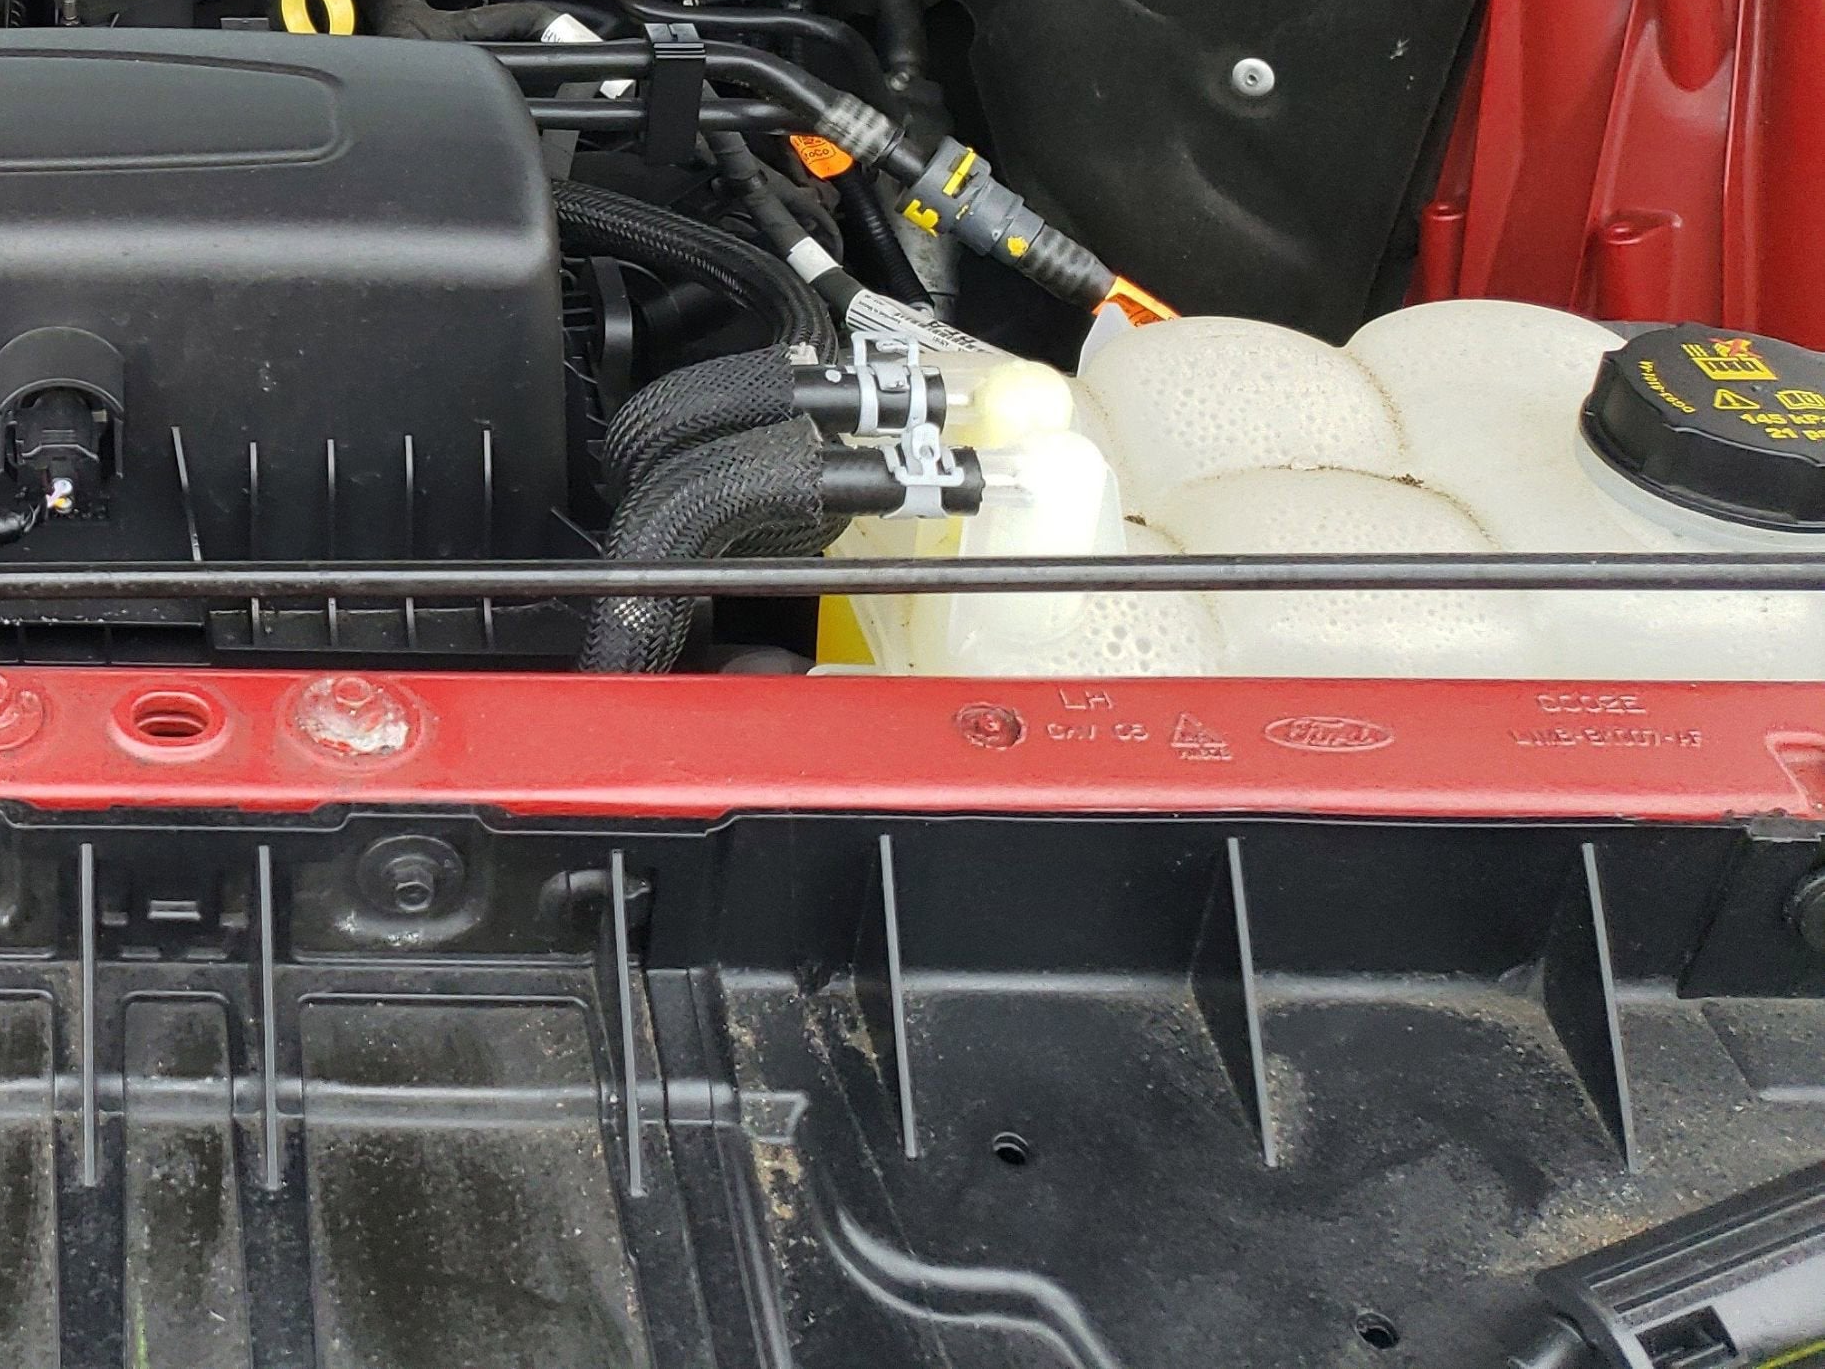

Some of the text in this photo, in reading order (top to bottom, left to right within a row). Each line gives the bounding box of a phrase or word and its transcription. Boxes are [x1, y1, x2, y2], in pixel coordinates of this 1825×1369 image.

[1739, 413, 1788, 424] 145
[1764, 427, 1799, 439] 21
[1059, 688, 1115, 710] LH
